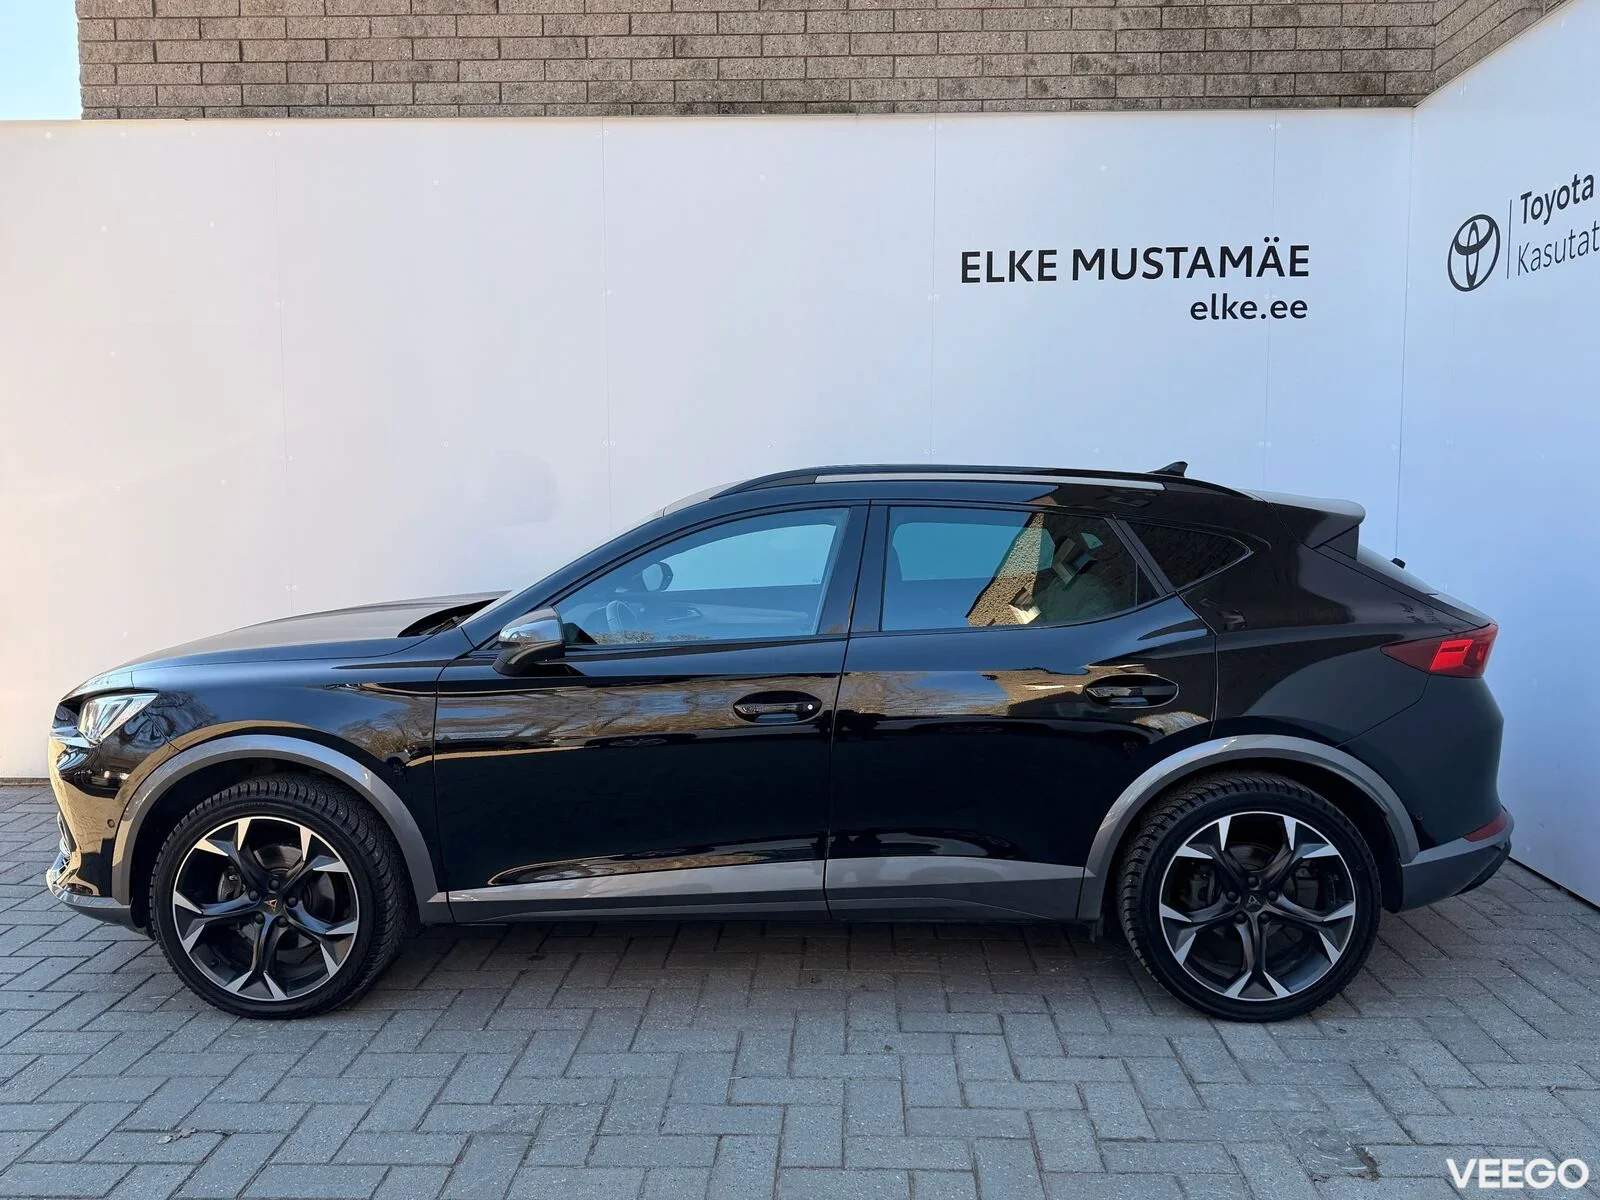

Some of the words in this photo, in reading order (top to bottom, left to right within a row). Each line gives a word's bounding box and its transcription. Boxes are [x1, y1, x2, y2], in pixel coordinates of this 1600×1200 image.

[1520, 173, 1595, 226] Toyota
[961, 249, 1058, 284] ELKE
[1072, 236, 1310, 281] MUSTAMÄE
[1517, 220, 1600, 276] Kasutat
[1190, 292, 1308, 321] elke.ee
